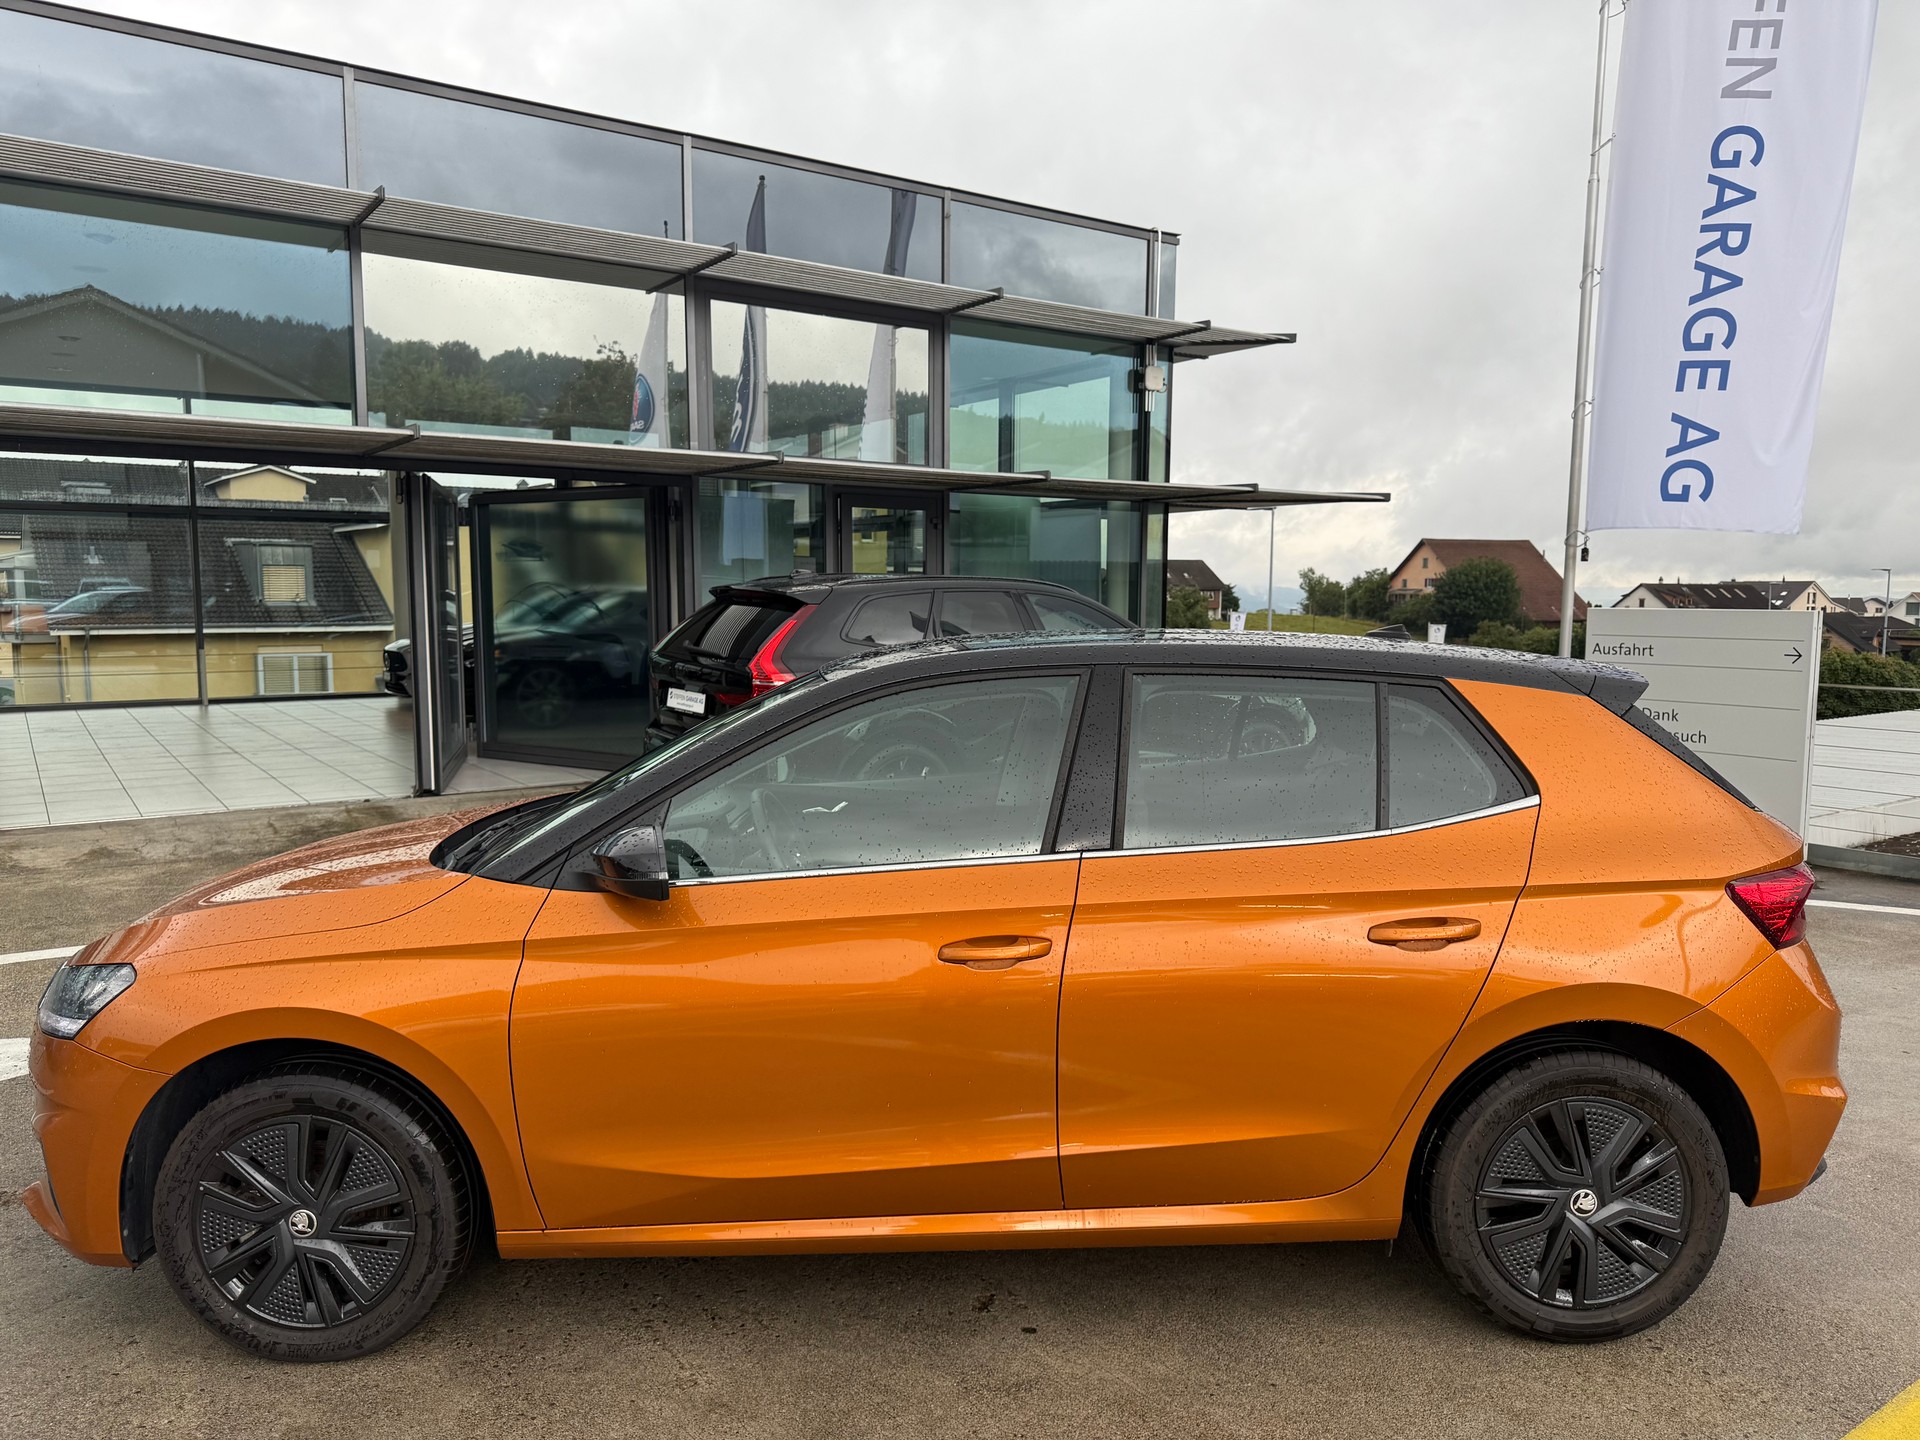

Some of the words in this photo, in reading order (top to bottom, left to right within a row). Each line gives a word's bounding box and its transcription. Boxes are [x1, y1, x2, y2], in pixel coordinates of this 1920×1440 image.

[1675, 125, 1766, 393] GARAGE
[1659, 412, 1720, 503] AG
[1592, 642, 1655, 657] Ausfahrt
[1642, 707, 1679, 722] Dank
[1669, 730, 1707, 744] such
